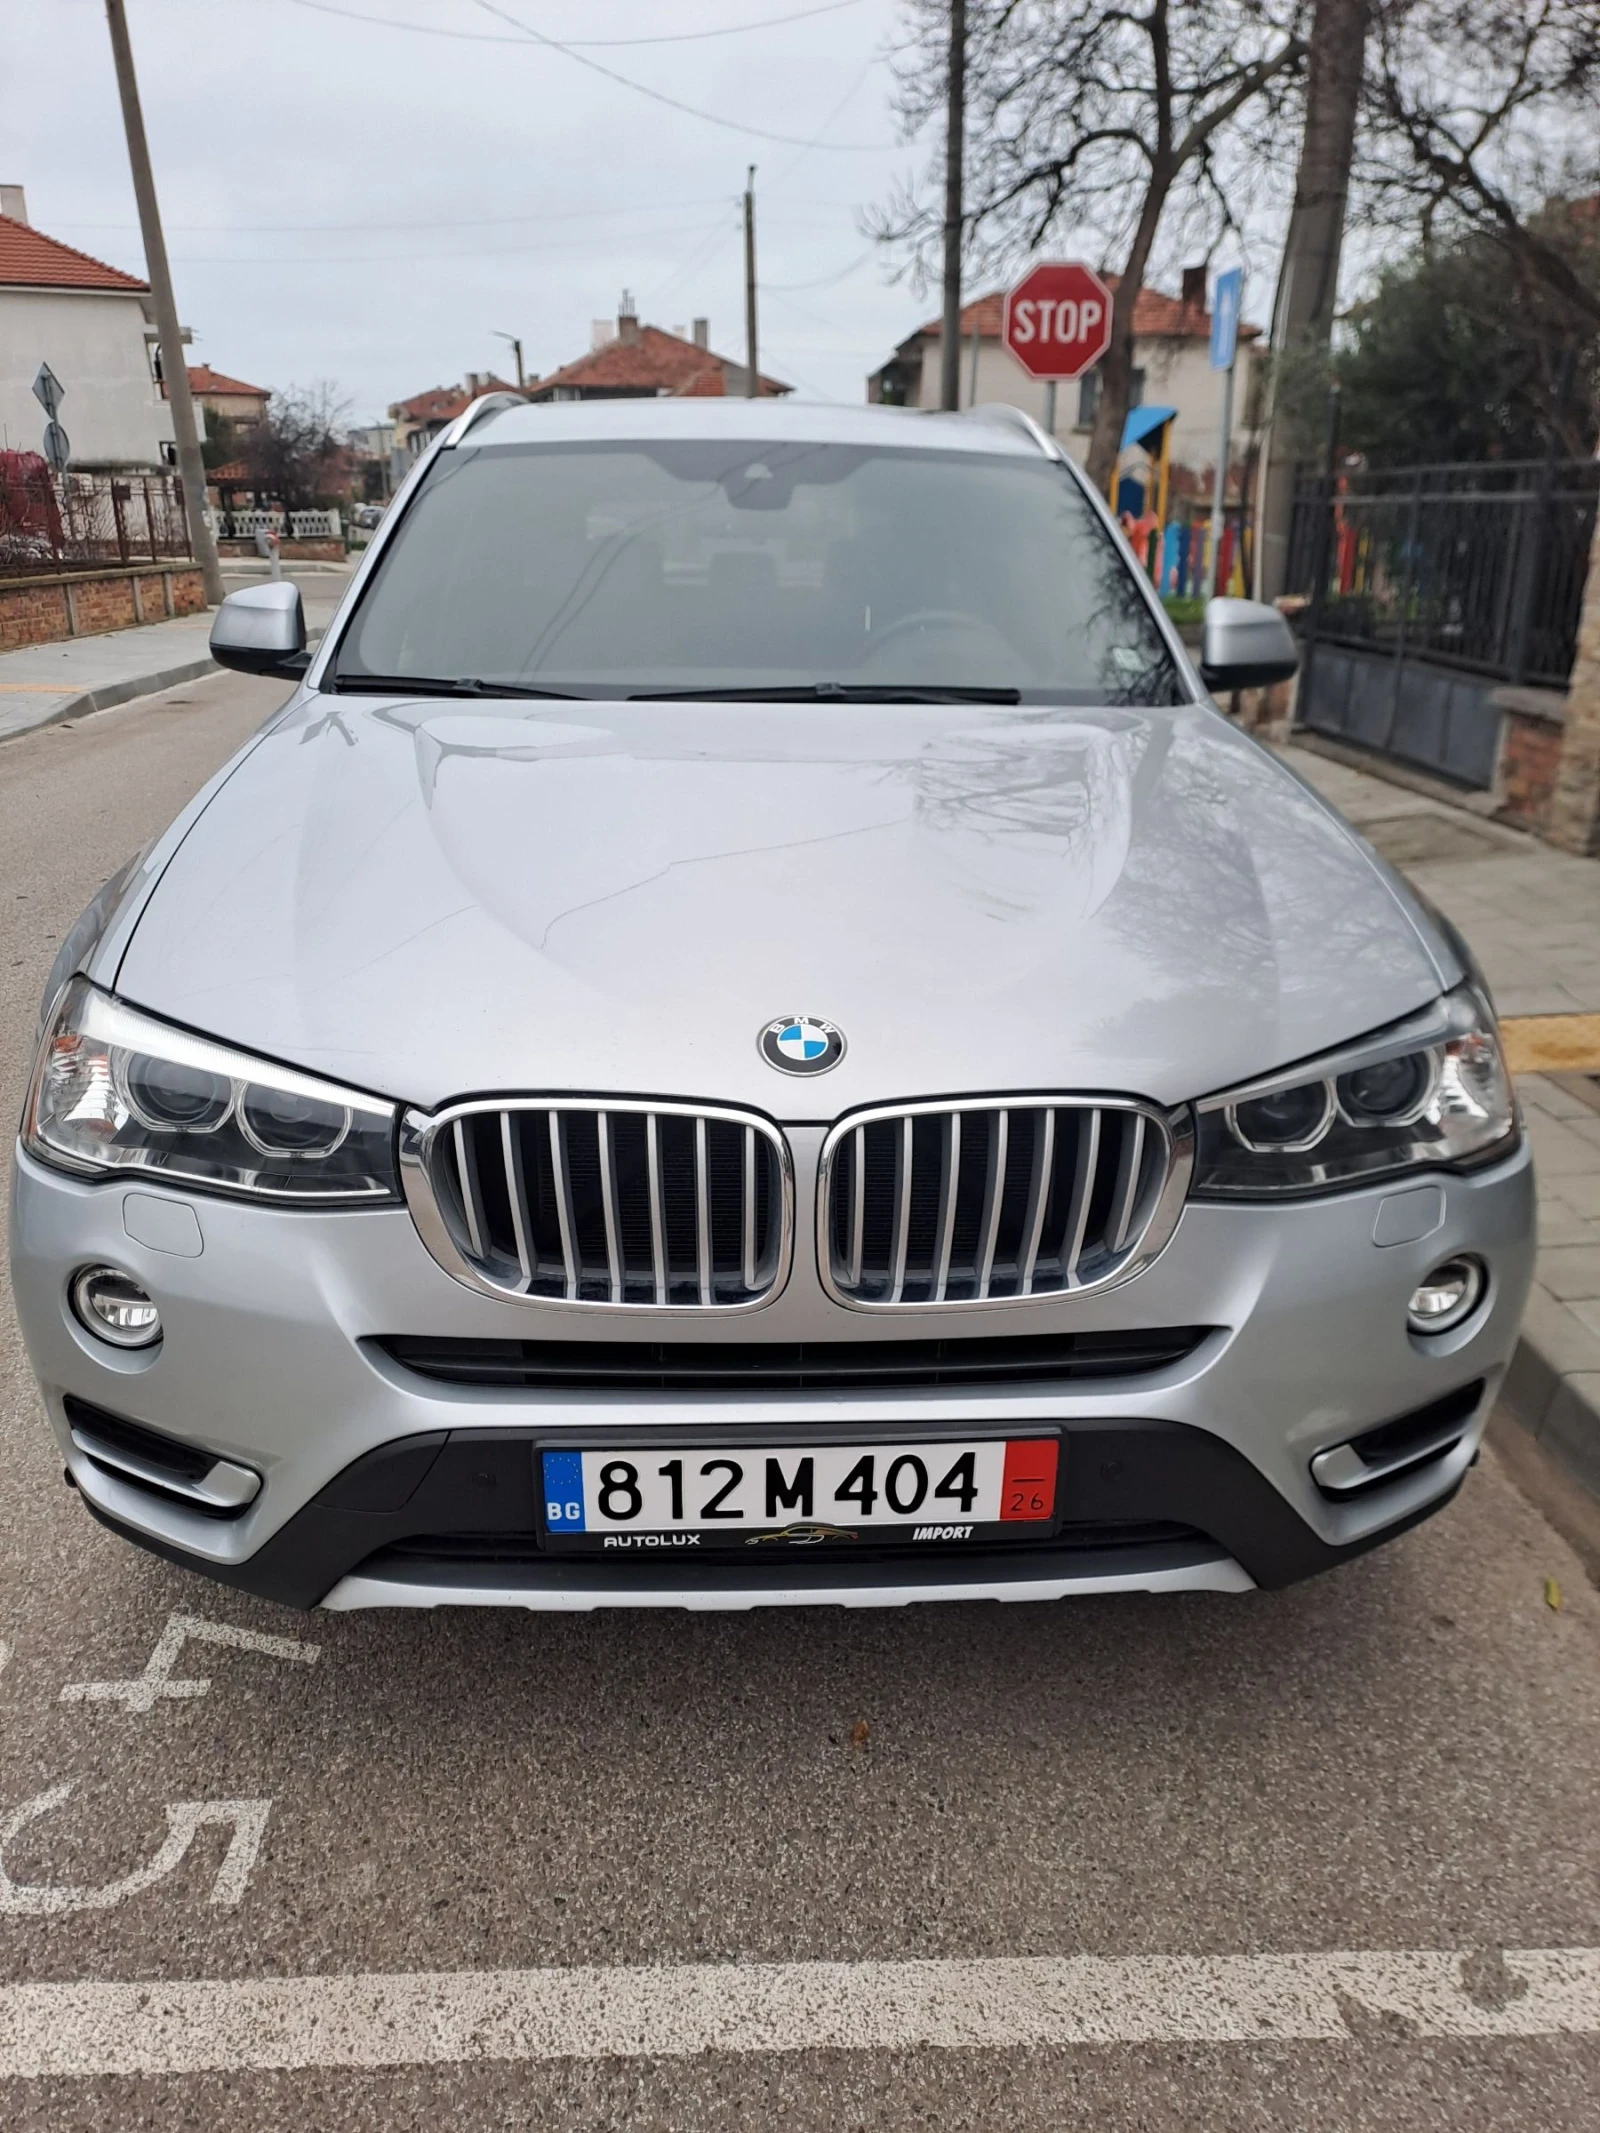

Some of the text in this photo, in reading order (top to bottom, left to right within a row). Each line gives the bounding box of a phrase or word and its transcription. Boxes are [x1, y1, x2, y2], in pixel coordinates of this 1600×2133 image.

[1014, 299, 1102, 344] STOP
[769, 1017, 835, 1034] BMW
[597, 1450, 978, 1520] 812 M 404
[1010, 1491, 1044, 1512] 26
[547, 1502, 580, 1520] BG
[603, 1534, 701, 1549] AUTOLUX
[912, 1525, 973, 1541] IMPORT
